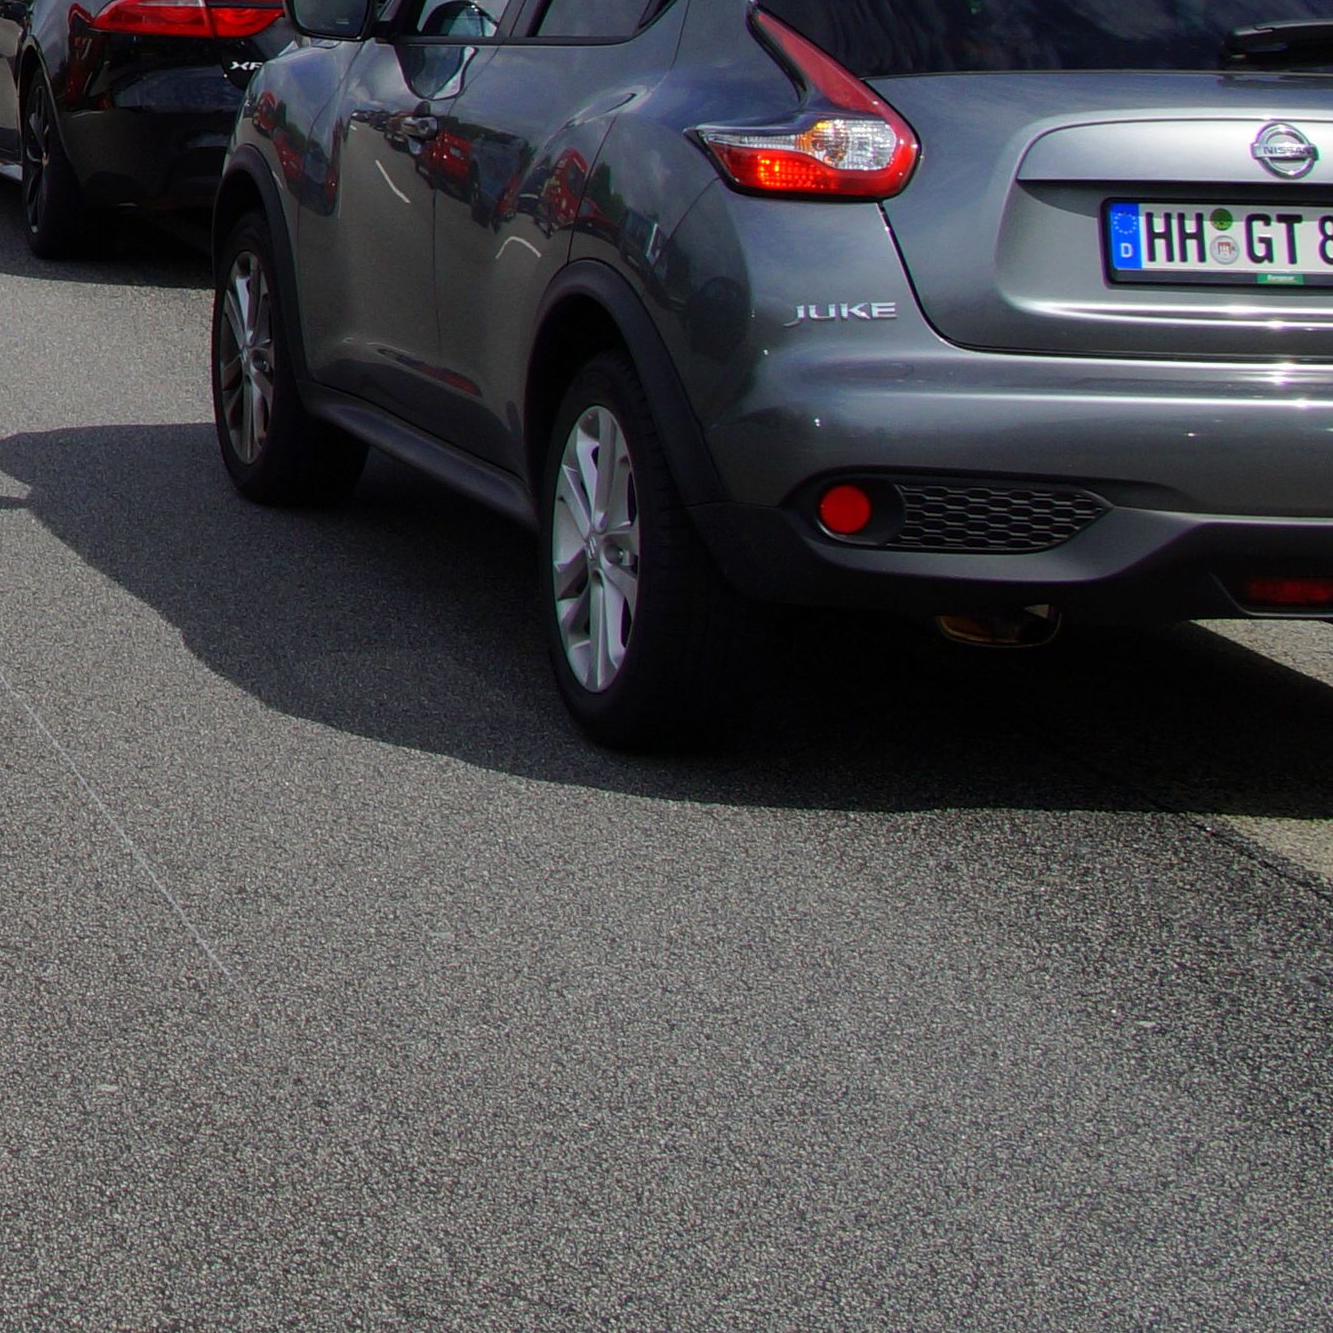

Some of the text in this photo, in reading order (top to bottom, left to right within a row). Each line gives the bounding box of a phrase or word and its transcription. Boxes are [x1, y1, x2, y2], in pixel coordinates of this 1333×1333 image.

[1262, 145, 1312, 156] NISSAN
[1120, 243, 1133, 258] D
[1144, 211, 1207, 264] HH
[1244, 213, 1303, 265] GT
[782, 301, 898, 328] JUKE
